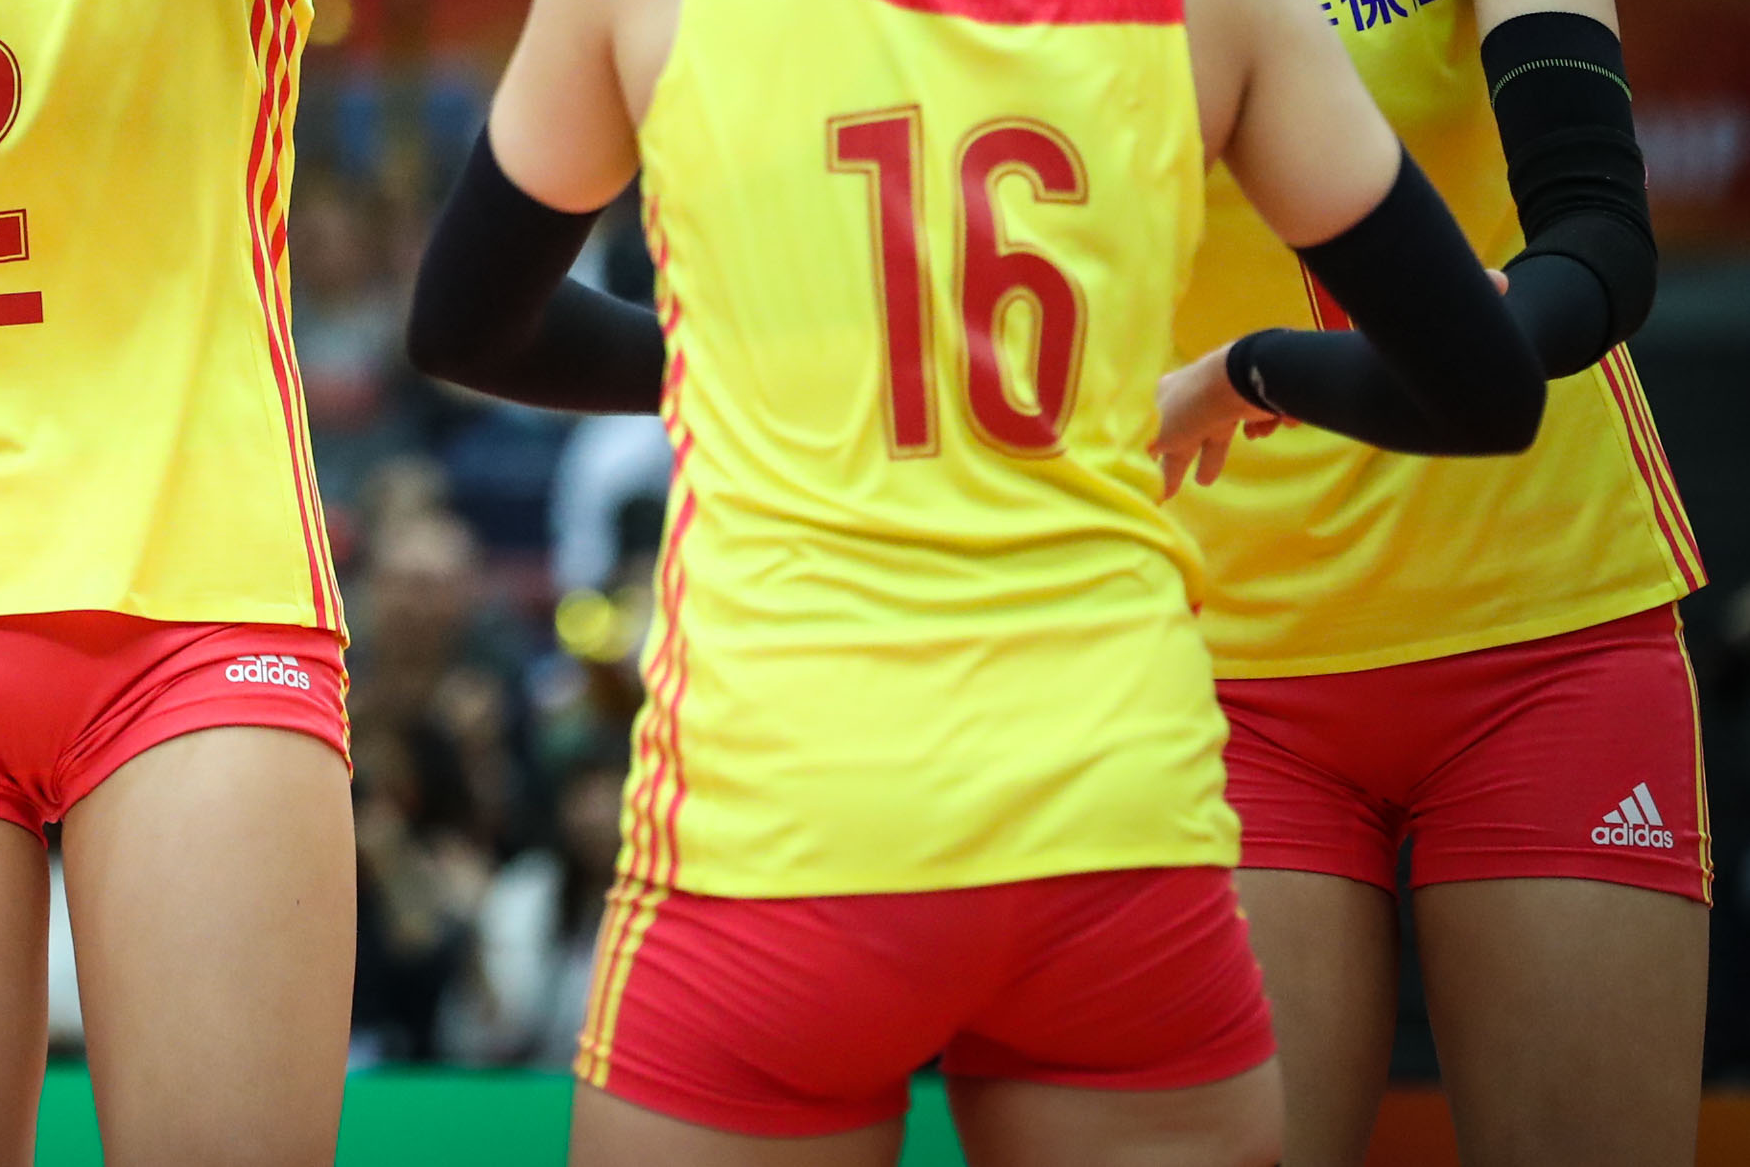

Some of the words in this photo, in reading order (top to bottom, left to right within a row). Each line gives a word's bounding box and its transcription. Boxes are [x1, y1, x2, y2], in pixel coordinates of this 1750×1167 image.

[826, 103, 1090, 462] 16
[225, 658, 311, 690] adidas
[1591, 821, 1675, 849] adidas
